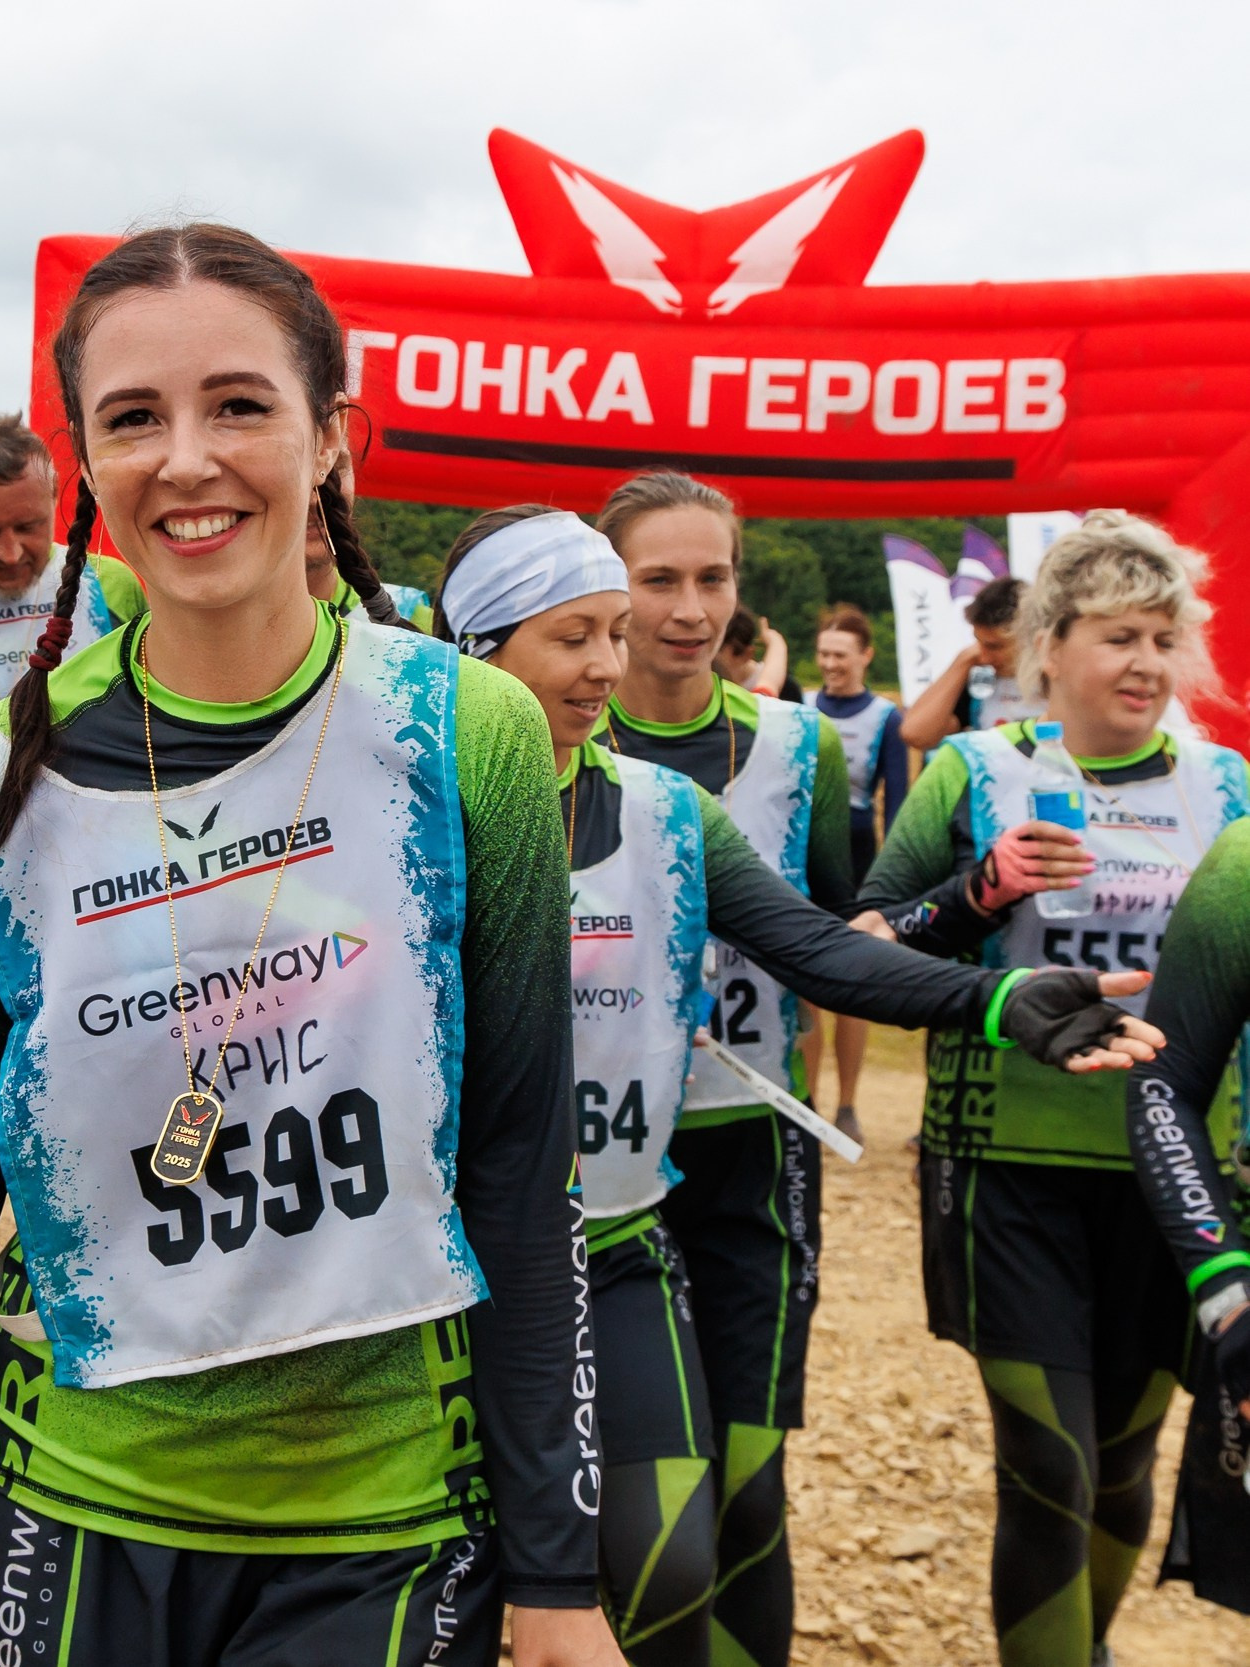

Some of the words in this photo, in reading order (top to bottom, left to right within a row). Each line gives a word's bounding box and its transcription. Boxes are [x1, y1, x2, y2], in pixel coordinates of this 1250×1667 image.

[346, 328, 655, 426] ГОНКА
[687, 355, 1068, 435] ГЕРОЕВ
[72, 863, 190, 915] ГОНКА
[198, 816, 333, 881] ГЕРОЕВ
[1107, 811, 1178, 827] ГЕРОЕВ
[78, 936, 329, 1037] Greenway
[170, 995, 286, 1039] GLOBAL
[185, 1019, 329, 1102] КРИС
[130, 1087, 390, 1267] 5599
[163, 1153, 191, 1168] 2025
[170, 1134, 200, 1147] ГЕРОЕВ
[176, 1125, 200, 1137] ГОНКА
[1140, 1078, 1220, 1221] Greenway
[569, 1198, 600, 1516] Greenway
[33, 1535, 62, 1655] GLOBA
